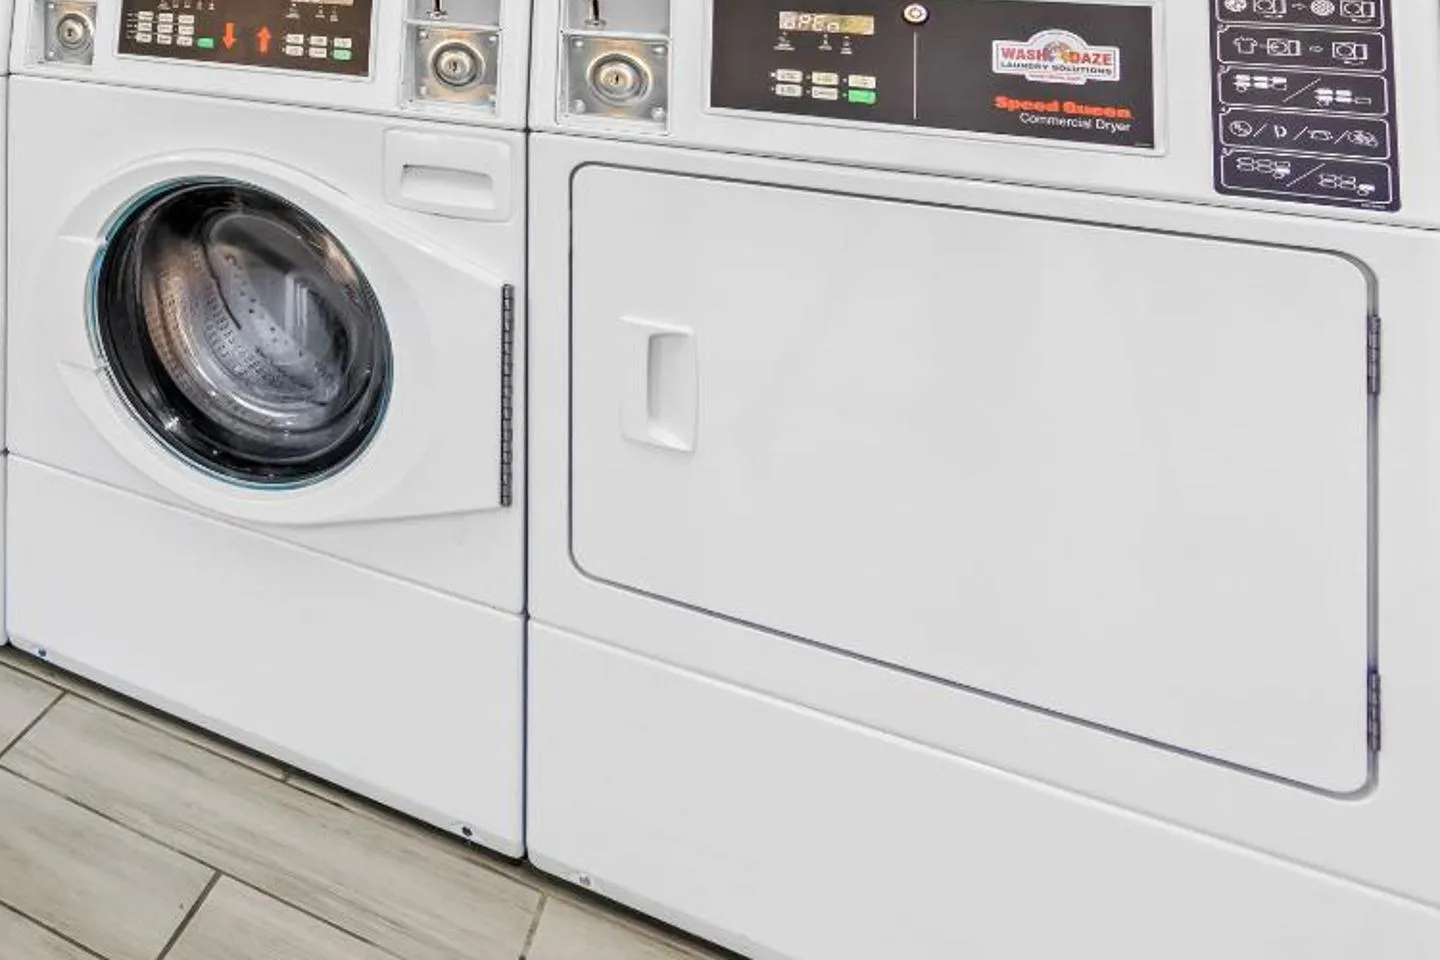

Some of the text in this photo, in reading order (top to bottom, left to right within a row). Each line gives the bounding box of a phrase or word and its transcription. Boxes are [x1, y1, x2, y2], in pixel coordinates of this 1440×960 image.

[1001, 47, 1113, 66] WASH DAZE
[1001, 62, 1112, 76] LAUNDRY SOLUTIONS
[994, 95, 1133, 119] Speed Queen
[1019, 112, 1132, 133] Commercial Dryer
